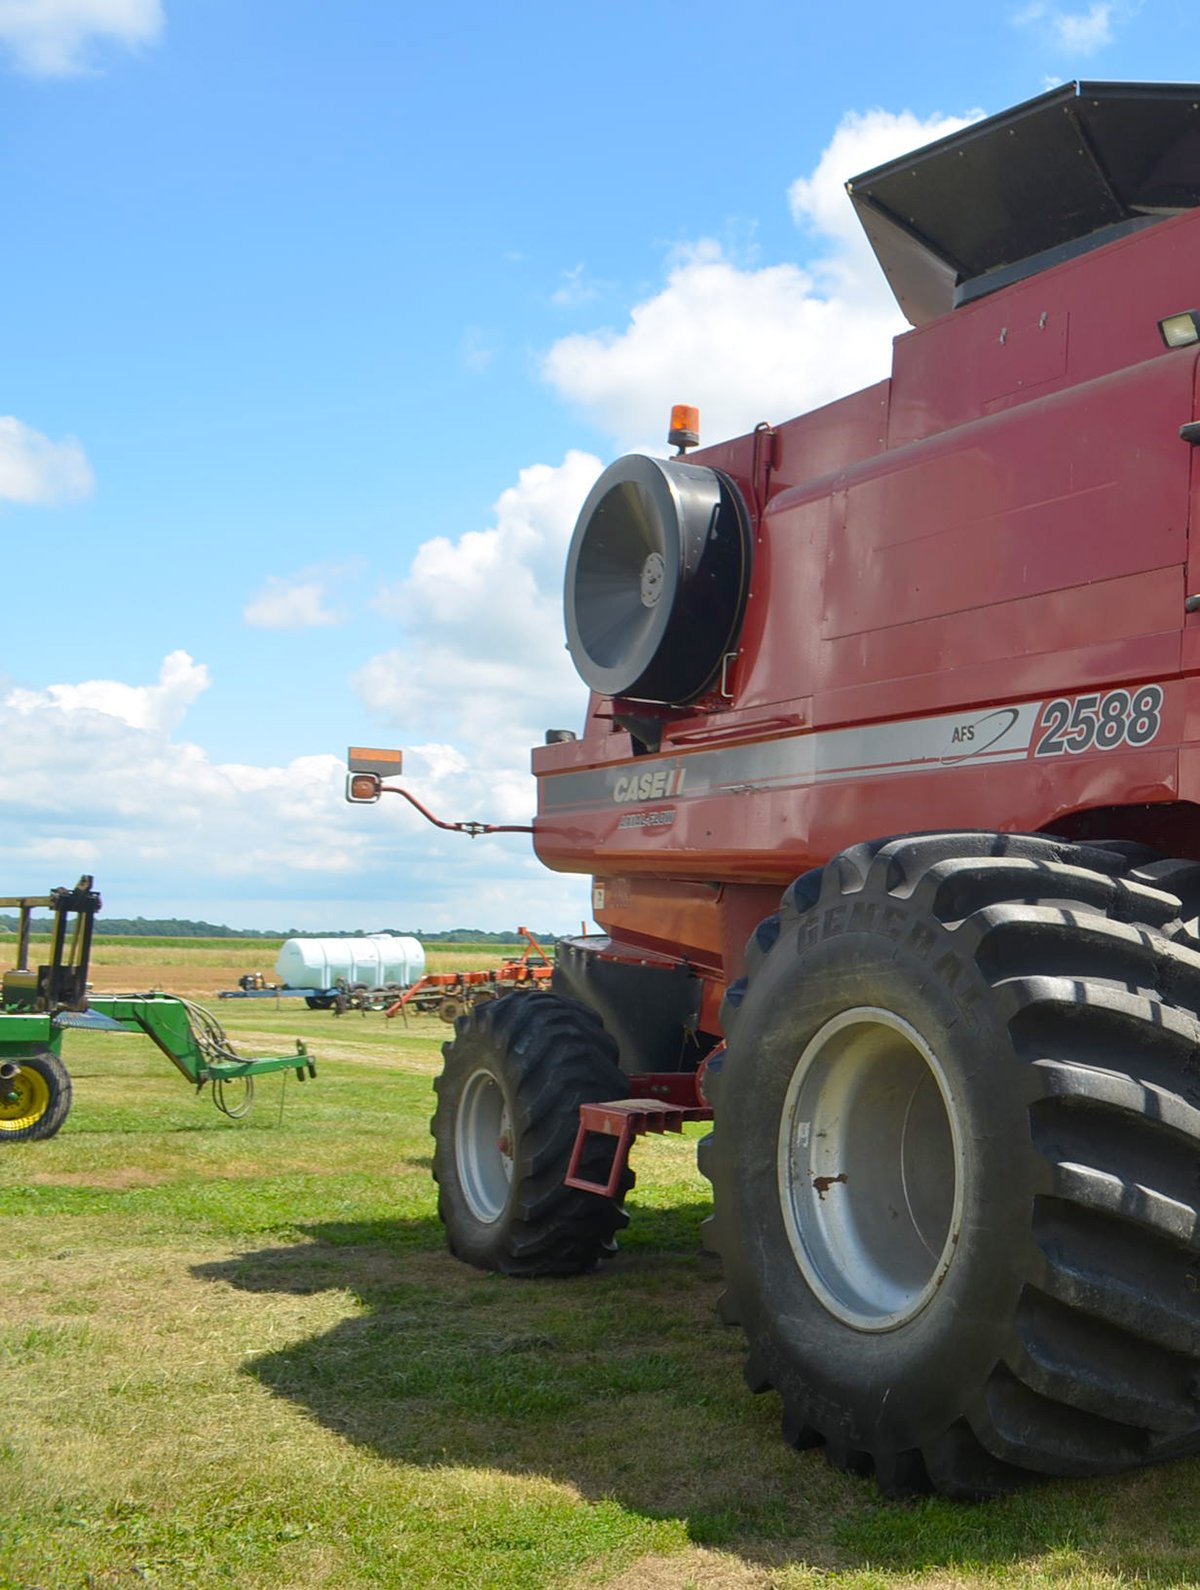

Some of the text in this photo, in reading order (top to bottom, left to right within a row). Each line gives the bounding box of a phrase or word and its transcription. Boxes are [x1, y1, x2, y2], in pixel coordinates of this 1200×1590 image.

[951, 724, 975, 743] AFS
[1034, 683, 1164, 758] 2588
[614, 772, 666, 803] CASE
